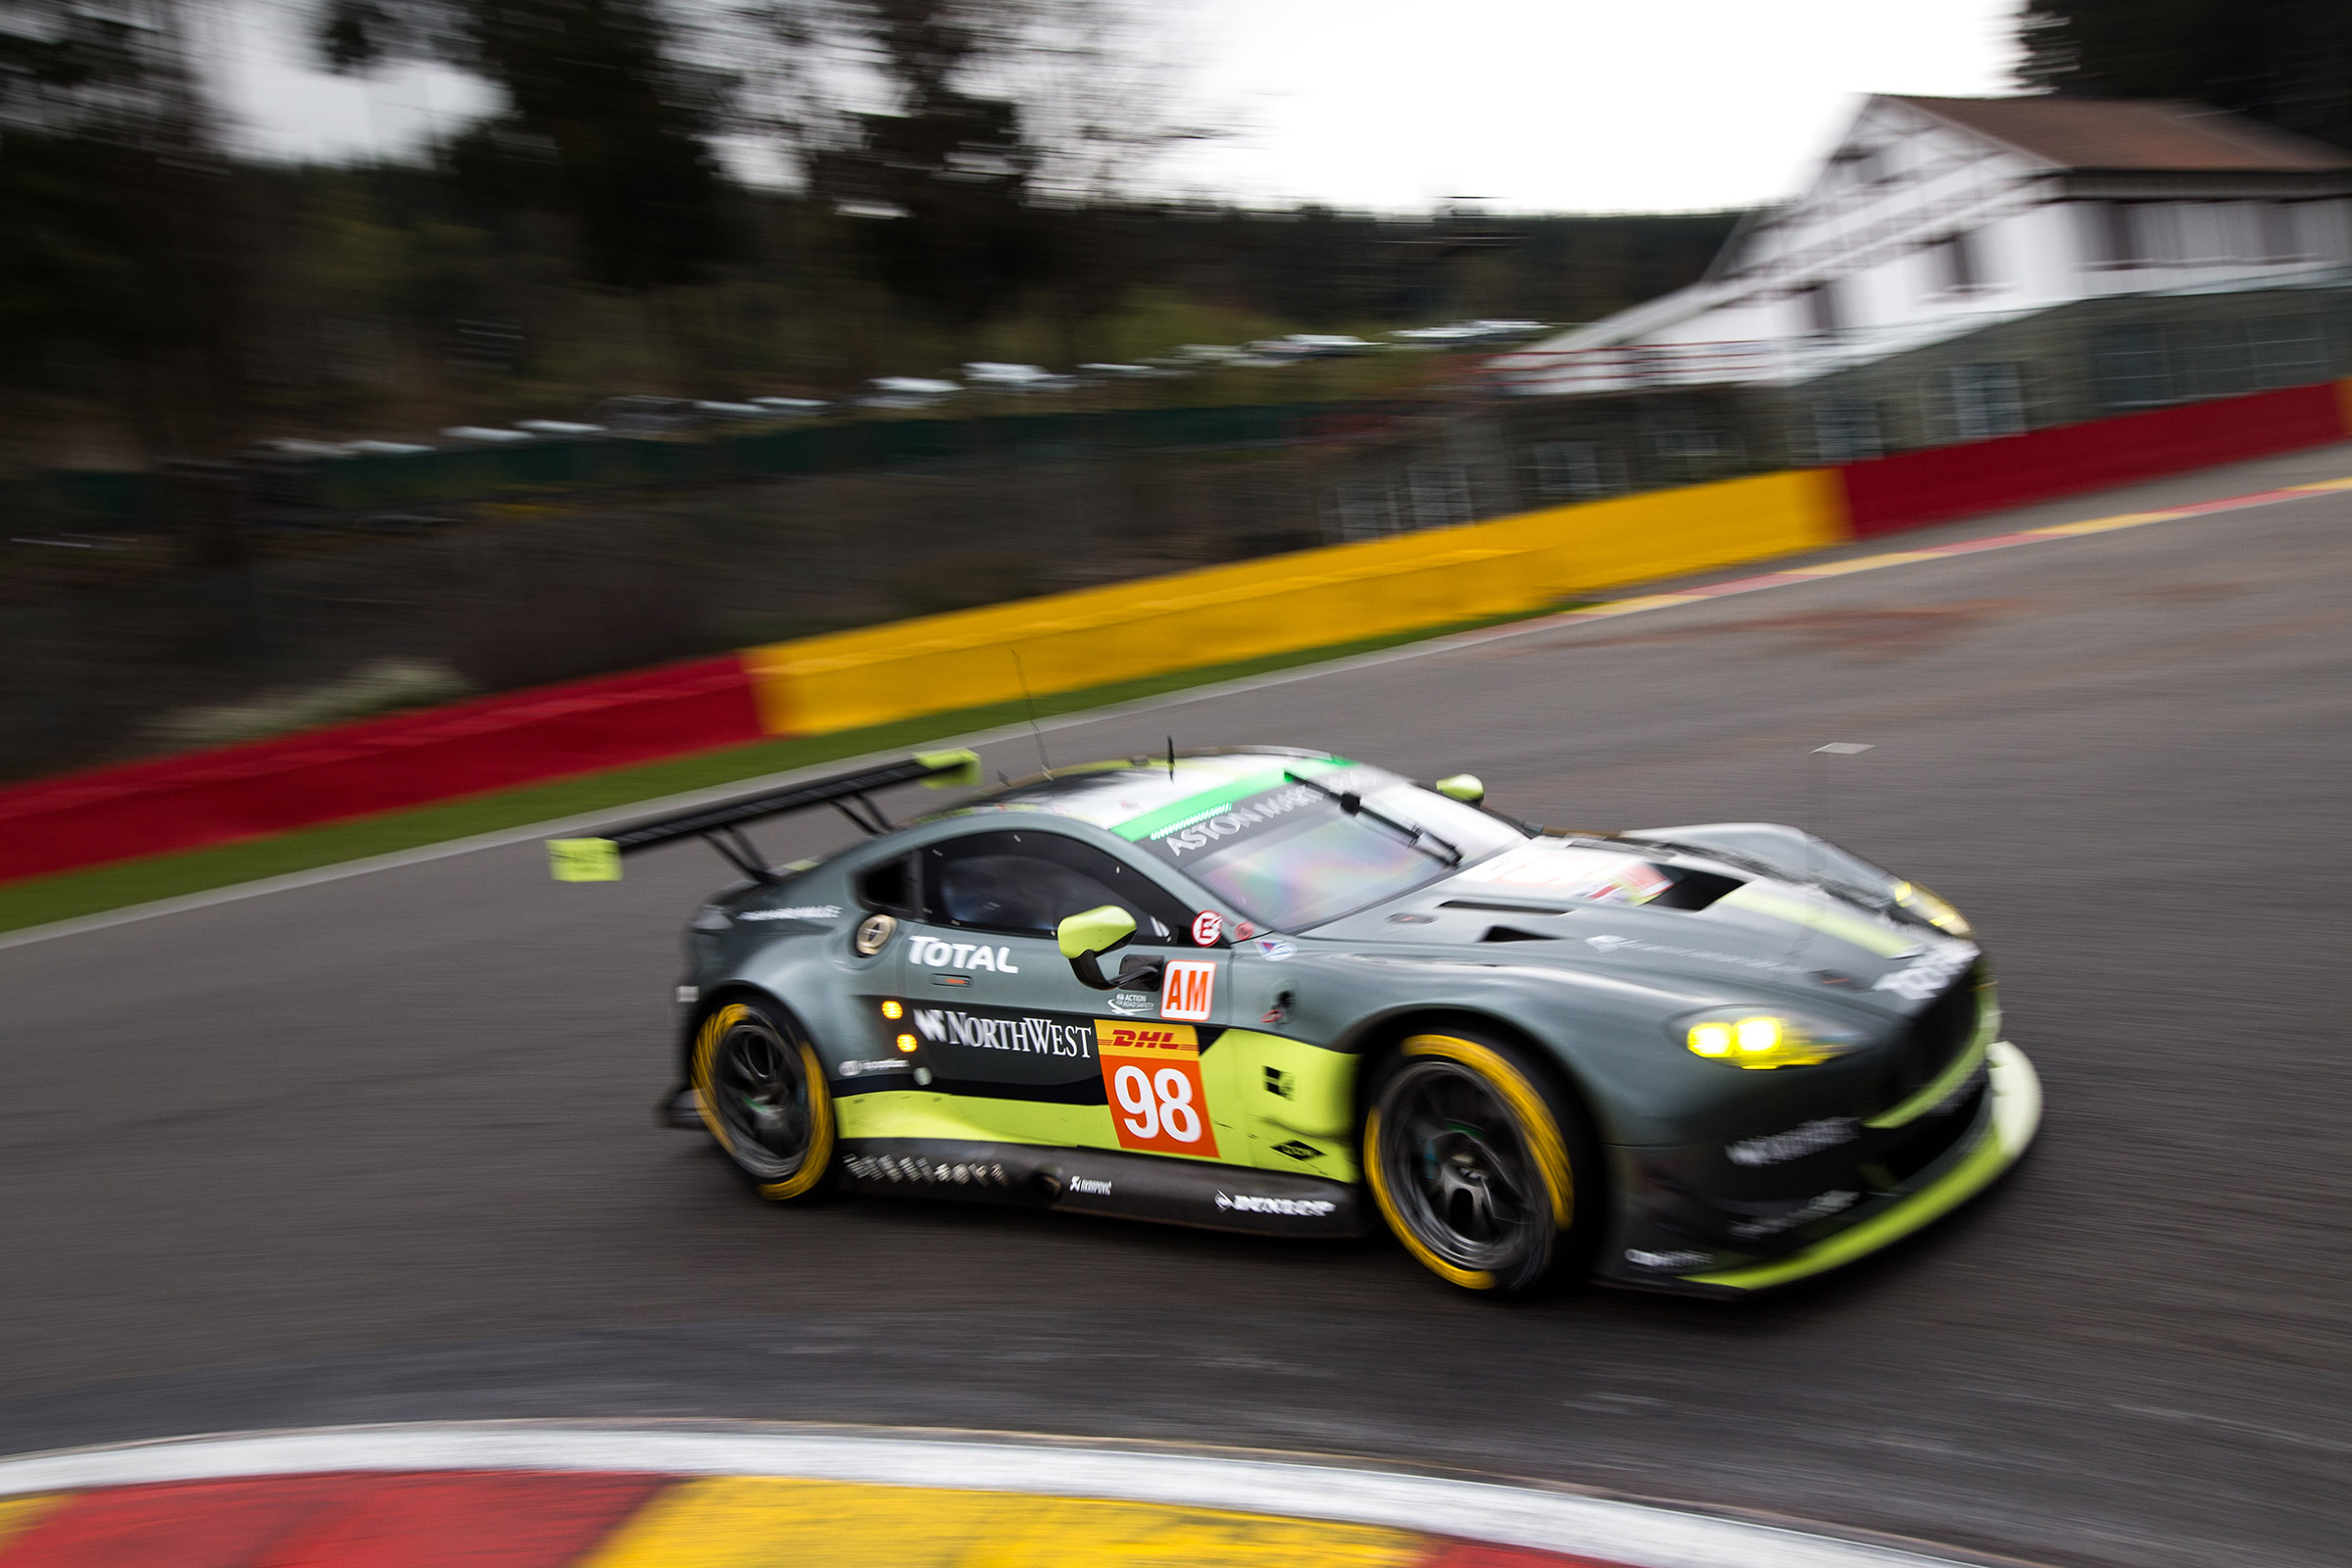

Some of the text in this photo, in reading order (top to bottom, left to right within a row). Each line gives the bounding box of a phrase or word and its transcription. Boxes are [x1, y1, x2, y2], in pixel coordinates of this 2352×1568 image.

[1166, 807, 1263, 857] ASTON
[908, 935, 1019, 974] TOTAL
[1125, 994, 1147, 1003] ACTION
[1165, 969, 1210, 1012] AM
[1112, 1029, 1179, 1051] DHL
[1114, 1065, 1201, 1143] 98
